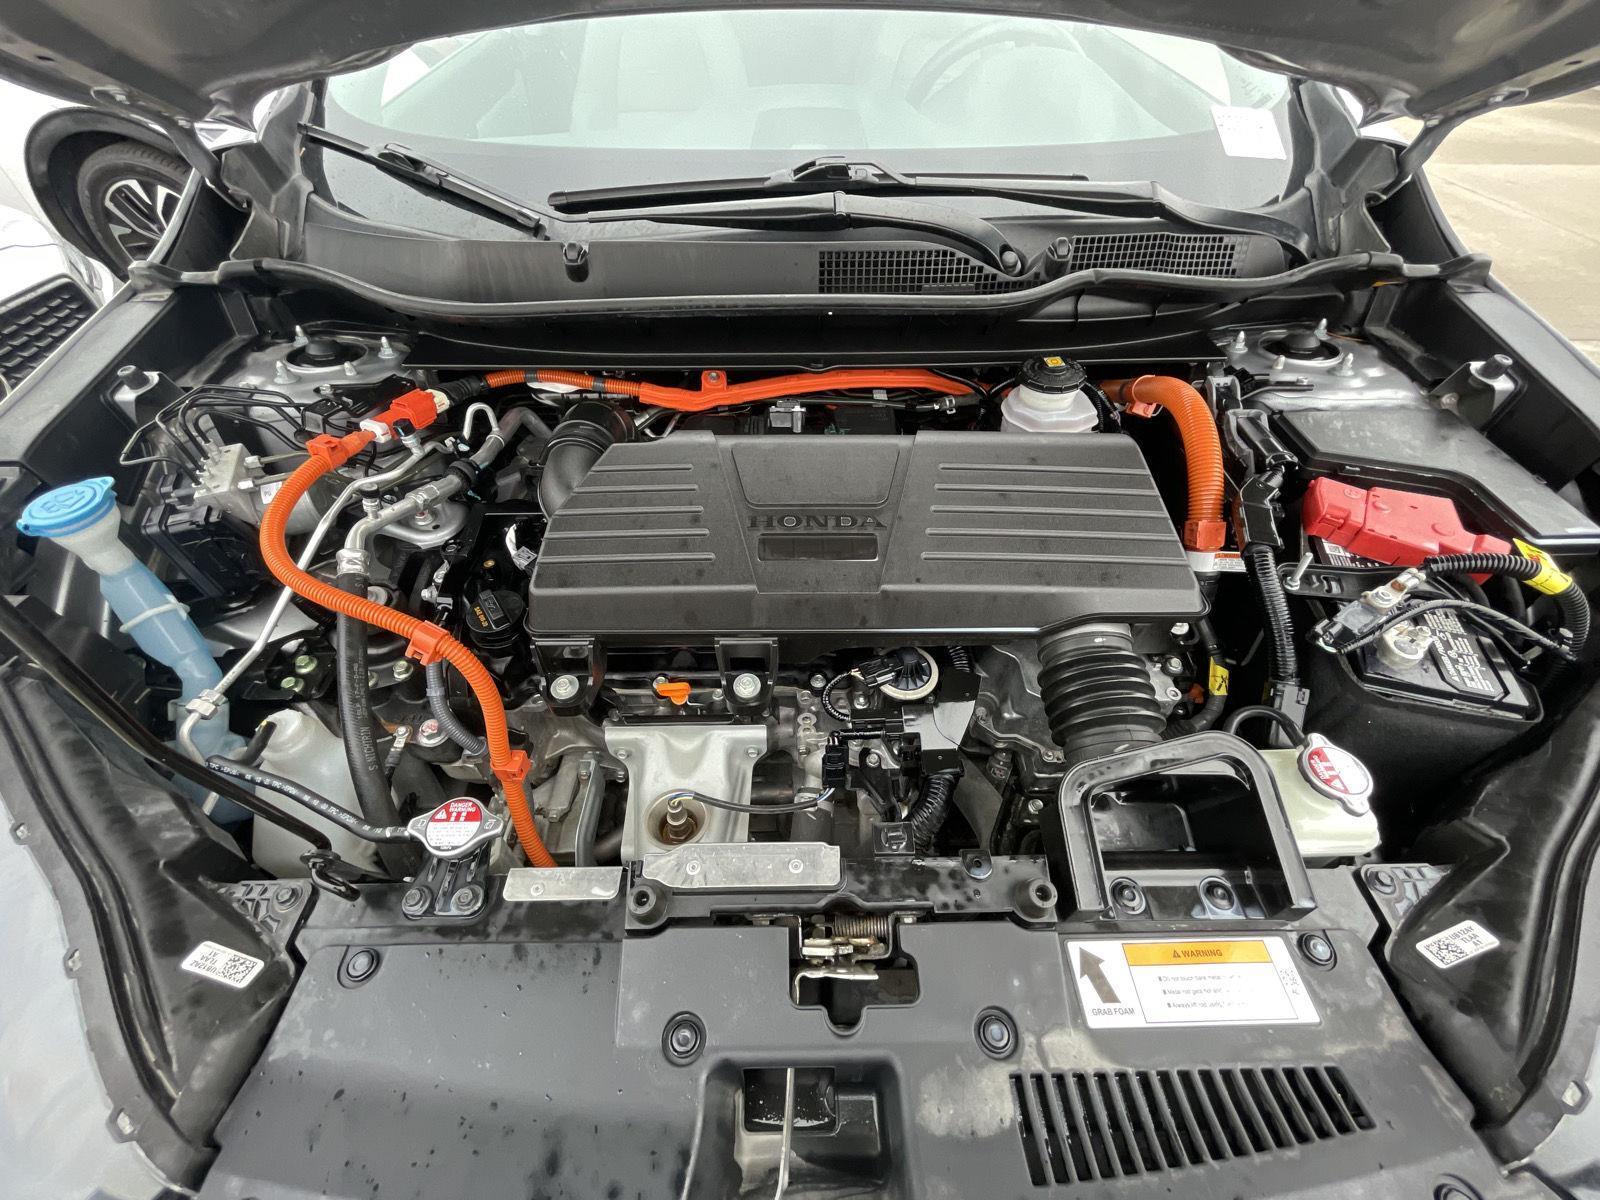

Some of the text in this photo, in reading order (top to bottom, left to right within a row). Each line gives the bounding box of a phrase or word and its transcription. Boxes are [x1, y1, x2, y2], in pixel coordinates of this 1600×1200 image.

[747, 515, 887, 530] HONDA
[1449, 926, 1474, 940] UB12AY
[1181, 948, 1223, 958] WARNING
[1091, 1007, 1136, 1016] GRAB FOAM
